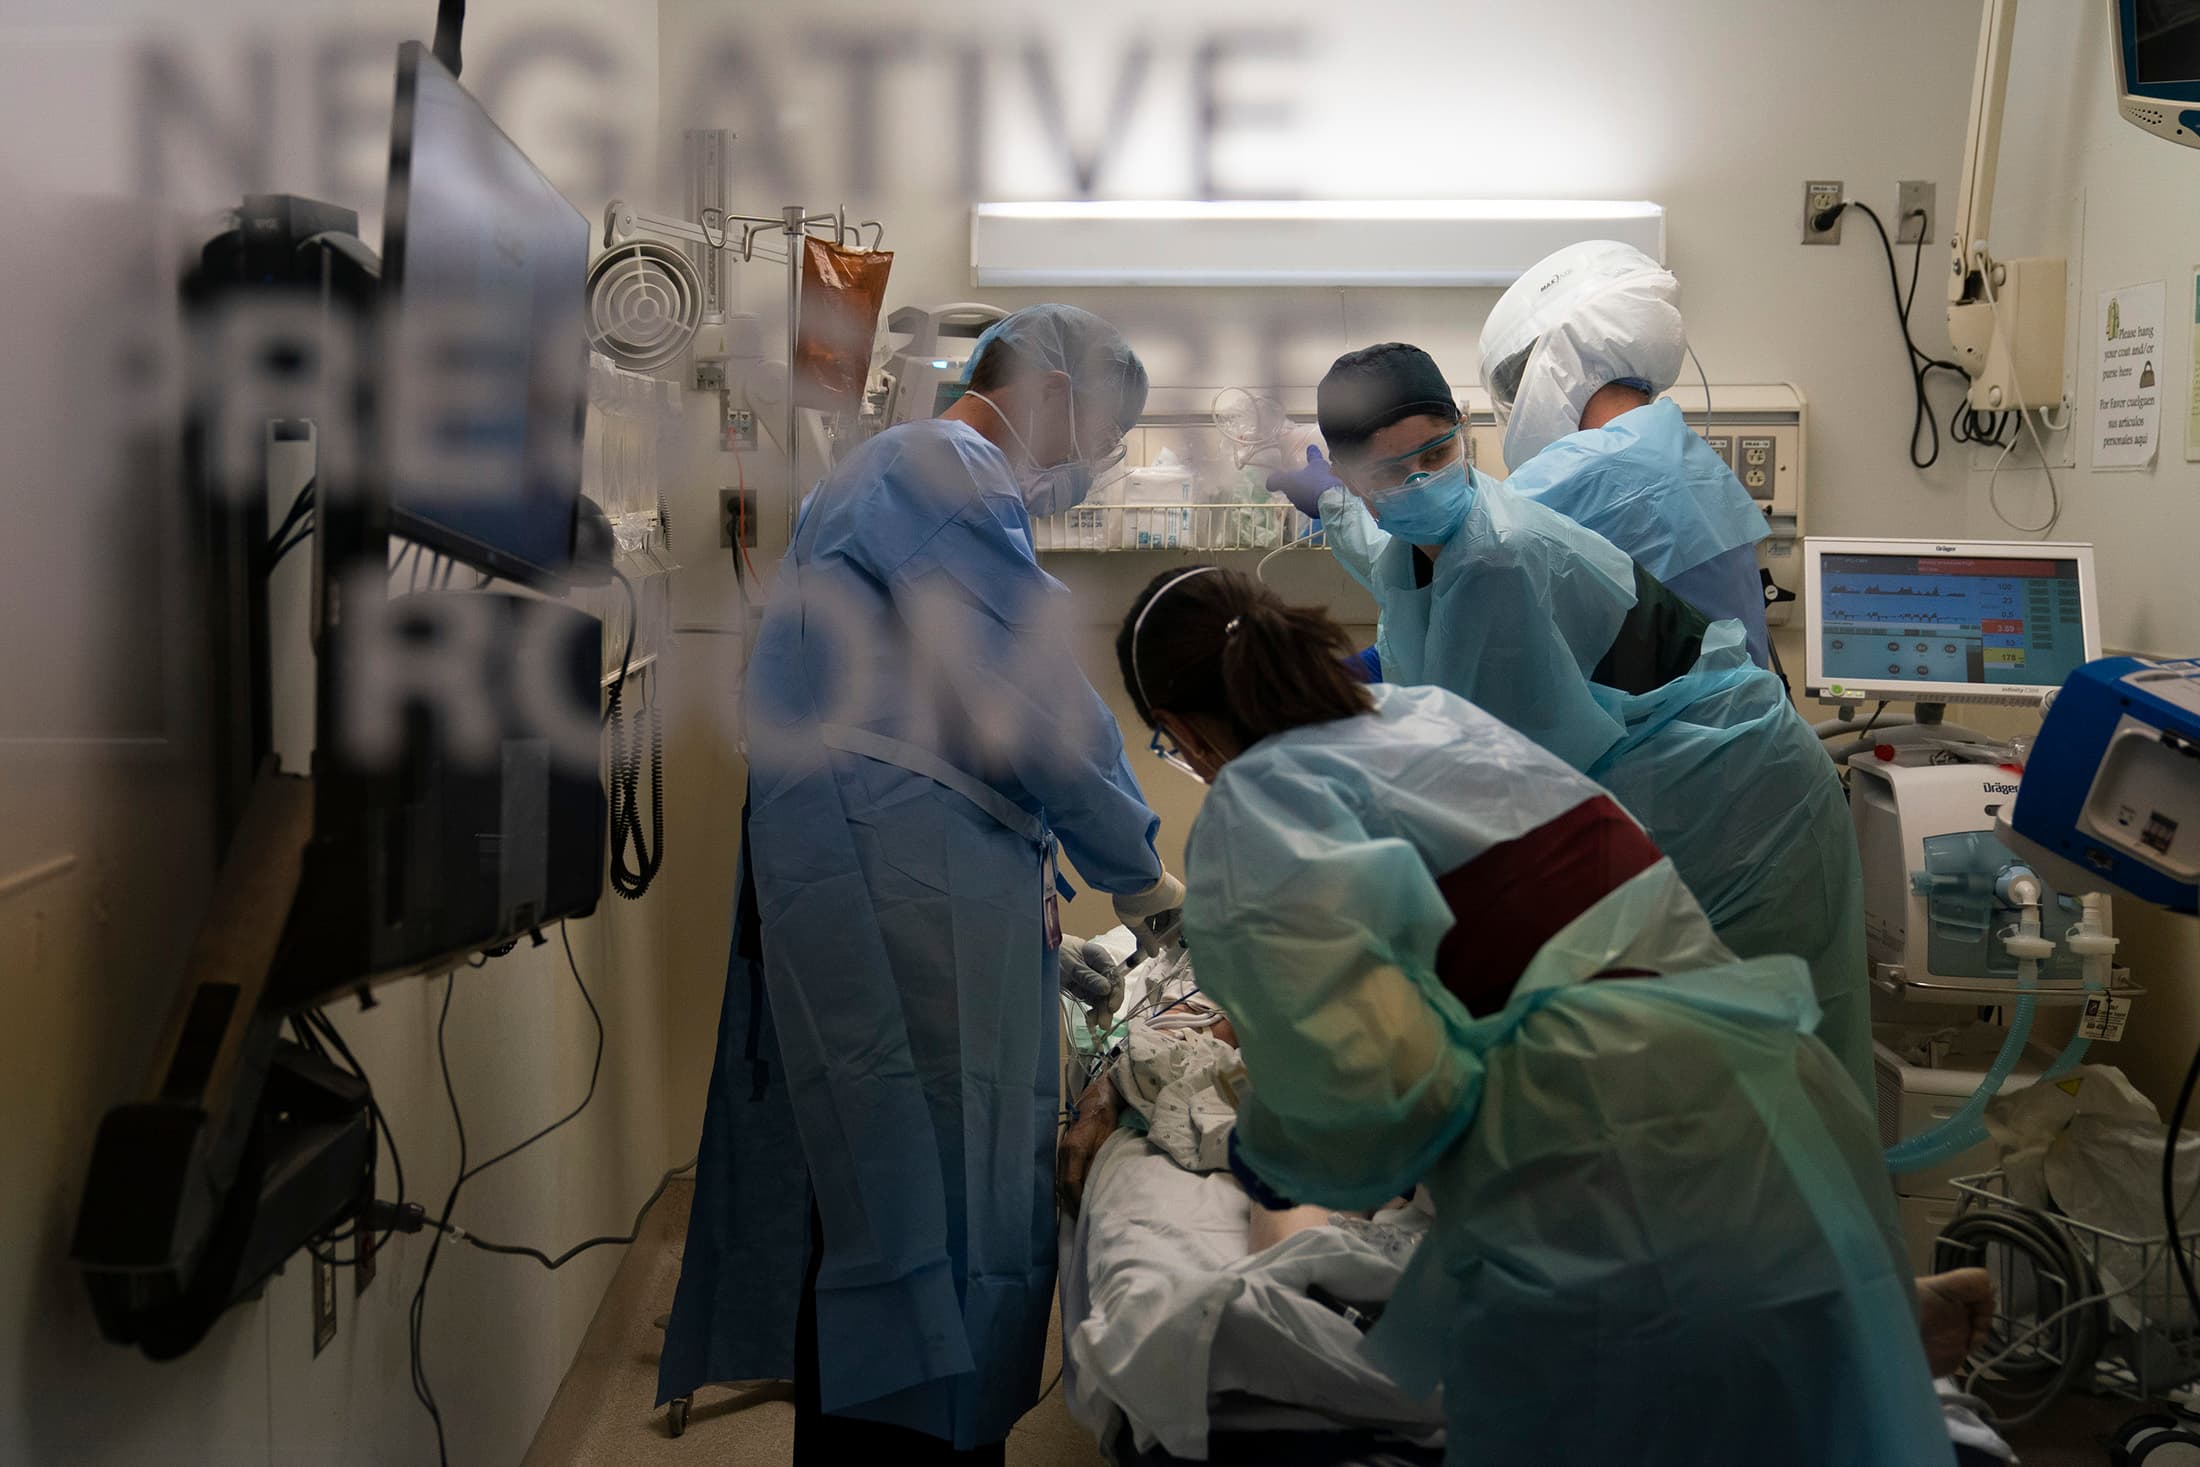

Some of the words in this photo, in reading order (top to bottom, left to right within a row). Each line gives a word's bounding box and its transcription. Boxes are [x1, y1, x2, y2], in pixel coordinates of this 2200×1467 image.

[128, 25, 1328, 206] NEGATIVE
[2118, 328, 2136, 340] Please
[2137, 325, 2154, 339] hang
[2103, 350, 2117, 362] your
[2118, 347, 2131, 357] coat
[2102, 369, 2118, 382] purse
[2119, 365, 2132, 376] here
[2099, 399, 2109, 410] Por
[2110, 397, 2126, 408] Favor
[2127, 395, 2154, 409] cuelguen
[2108, 420, 2118, 428] sus
[2103, 434, 2133, 449] personales
[342, 580, 1085, 766] ROOM
[1983, 782, 2019, 795] Dräger
